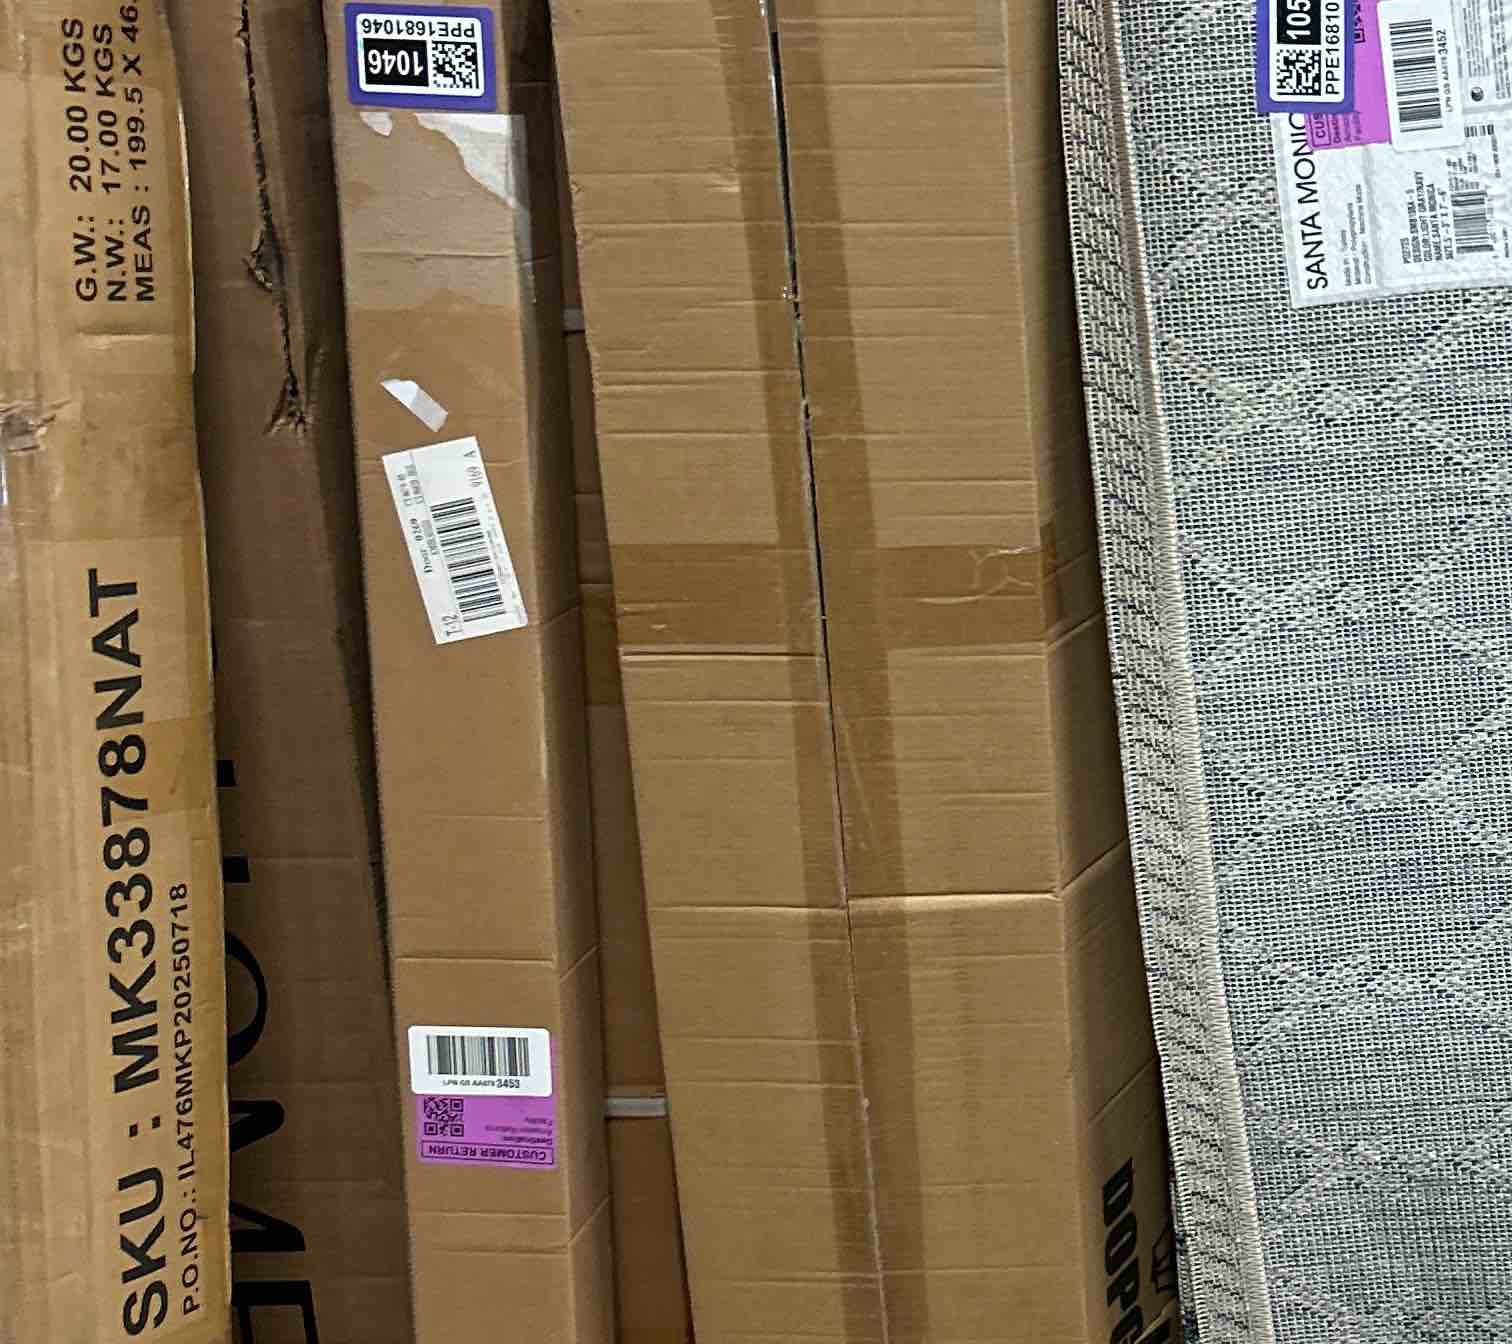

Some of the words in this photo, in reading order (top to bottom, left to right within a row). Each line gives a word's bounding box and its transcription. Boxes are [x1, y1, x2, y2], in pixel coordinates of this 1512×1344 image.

[61, 17, 86, 93] KGS
[93, 23, 116, 99] KGS
[123, 53, 143, 76] X
[361, 18, 475, 38] PPE1681046
[367, 49, 424, 76] 1046
[66, 105, 94, 193] 20.00
[97, 109, 123, 195] 17.00
[124, 86, 148, 171] 199.5
[74, 215, 98, 303] G.W.:
[102, 217, 127, 303] N.W.:
[131, 205, 155, 303] MEAS
[1301, 210, 1329, 290] SANTA
[88, 567, 161, 1094] MK33878NAT
[168, 881, 196, 1180] IL476MKP20250718
[428, 1144, 477, 1157] RETURN
[480, 1146, 547, 1161] CUSTOMER
[116, 1175, 169, 1338] SKU
[173, 1189, 203, 1315] P.O.NO.:
